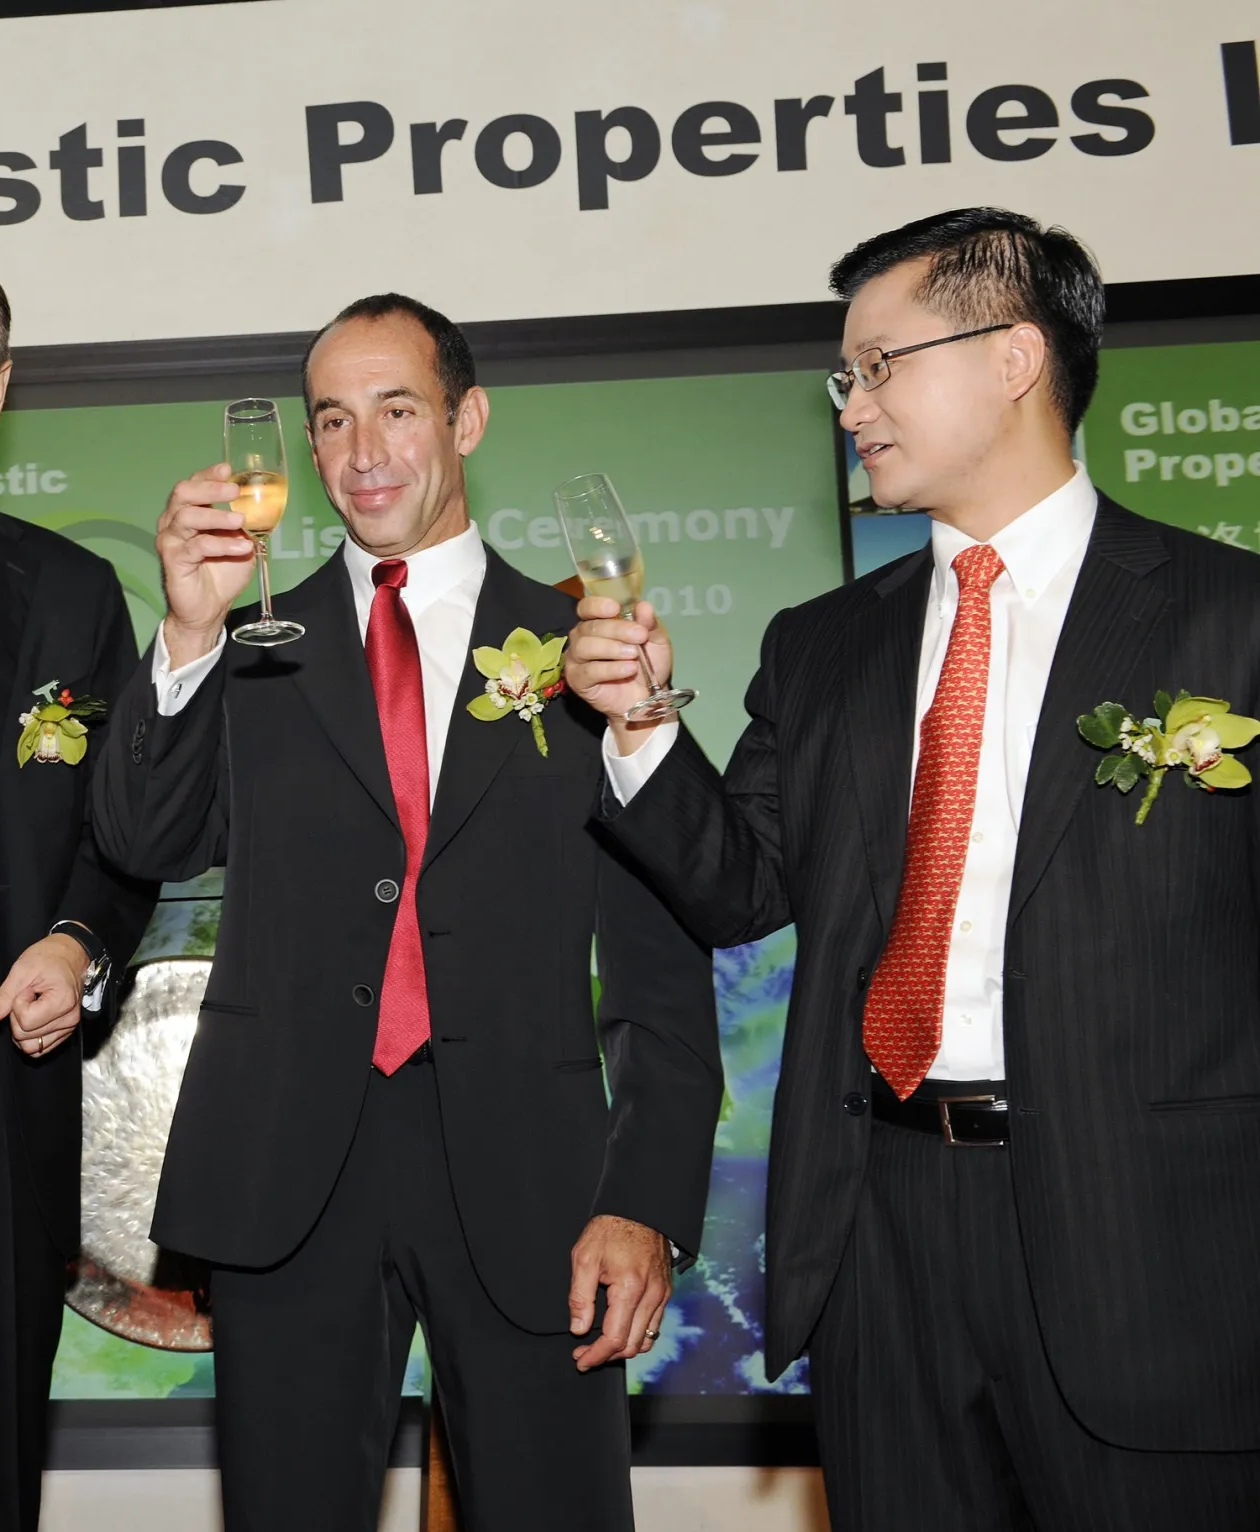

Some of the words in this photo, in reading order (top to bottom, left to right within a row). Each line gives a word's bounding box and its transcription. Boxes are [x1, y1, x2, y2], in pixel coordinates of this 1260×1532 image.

[305, 62, 1156, 212] Properties
[489, 506, 794, 549] Ceremony
[646, 584, 732, 616] 010
